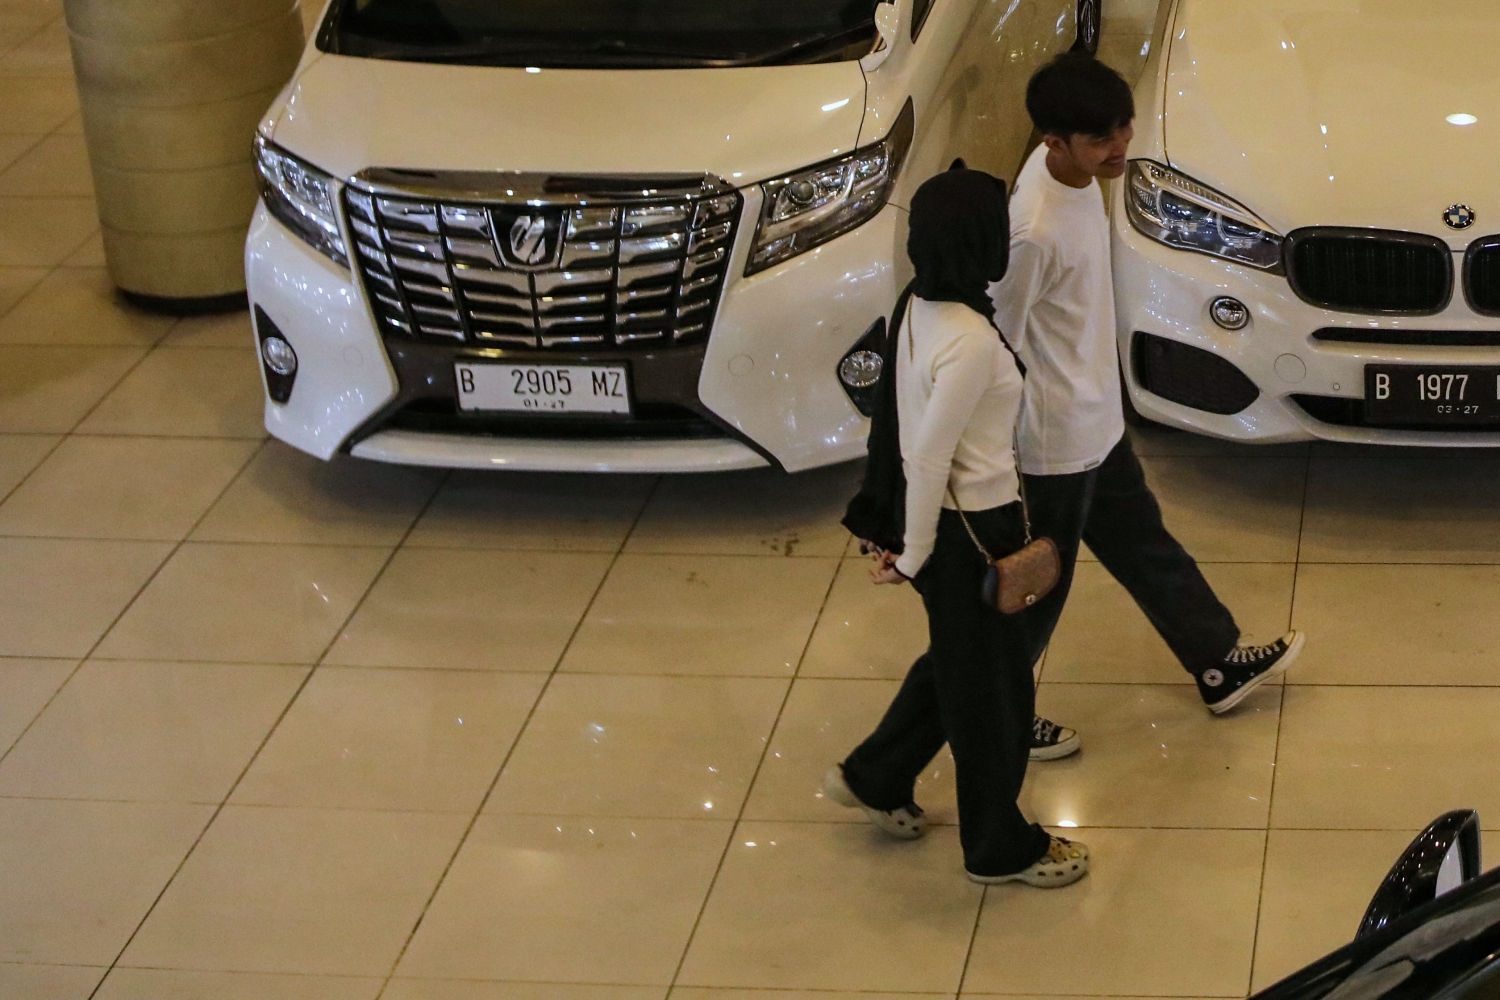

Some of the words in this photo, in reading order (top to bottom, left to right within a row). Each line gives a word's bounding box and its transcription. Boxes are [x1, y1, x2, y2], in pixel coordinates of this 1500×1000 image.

[460, 368, 475, 393] B
[511, 369, 572, 395] 2905
[591, 371, 623, 397] MZ
[1376, 373, 1390, 400] B
[1417, 374, 1469, 400] 1977
